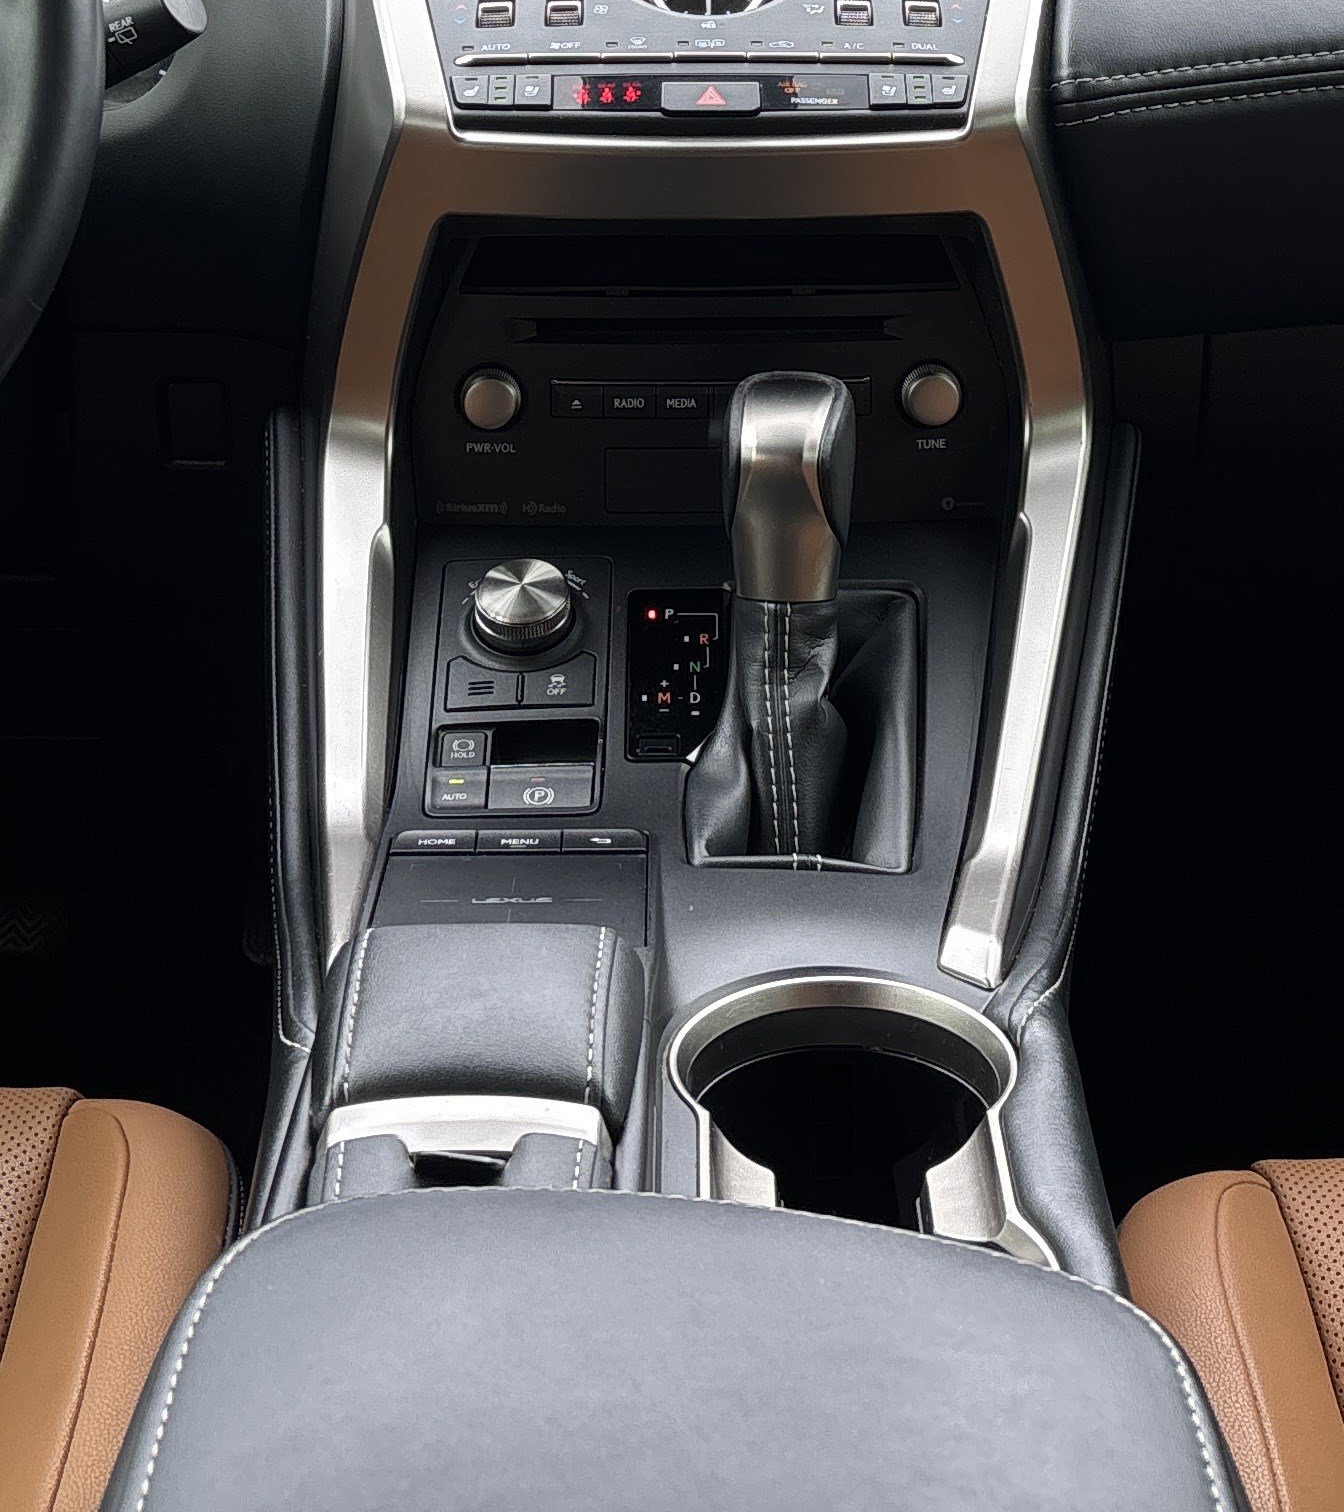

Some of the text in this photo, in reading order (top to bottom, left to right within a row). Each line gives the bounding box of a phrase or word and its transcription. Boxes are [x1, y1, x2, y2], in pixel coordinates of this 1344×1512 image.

[109, 16, 134, 32] REAR
[481, 42, 511, 51] AUTO
[560, 41, 582, 49] OFF
[843, 42, 864, 50] A/C
[911, 42, 940, 51] DUAL
[790, 97, 839, 105] PASSENGER
[613, 397, 645, 409] RADIO
[666, 397, 697, 409] MEDIA
[916, 438, 947, 449] TUNE
[565, 569, 587, 586] Sport
[664, 608, 674, 620] P
[699, 633, 709, 645] R
[689, 661, 701, 673] N
[546, 687, 566, 696] OFF
[657, 691, 701, 704] M D
[450, 751, 476, 759] HOLD
[441, 792, 468, 801] AUTO
[417, 838, 456, 846] HOME
[500, 838, 540, 846] MENU
